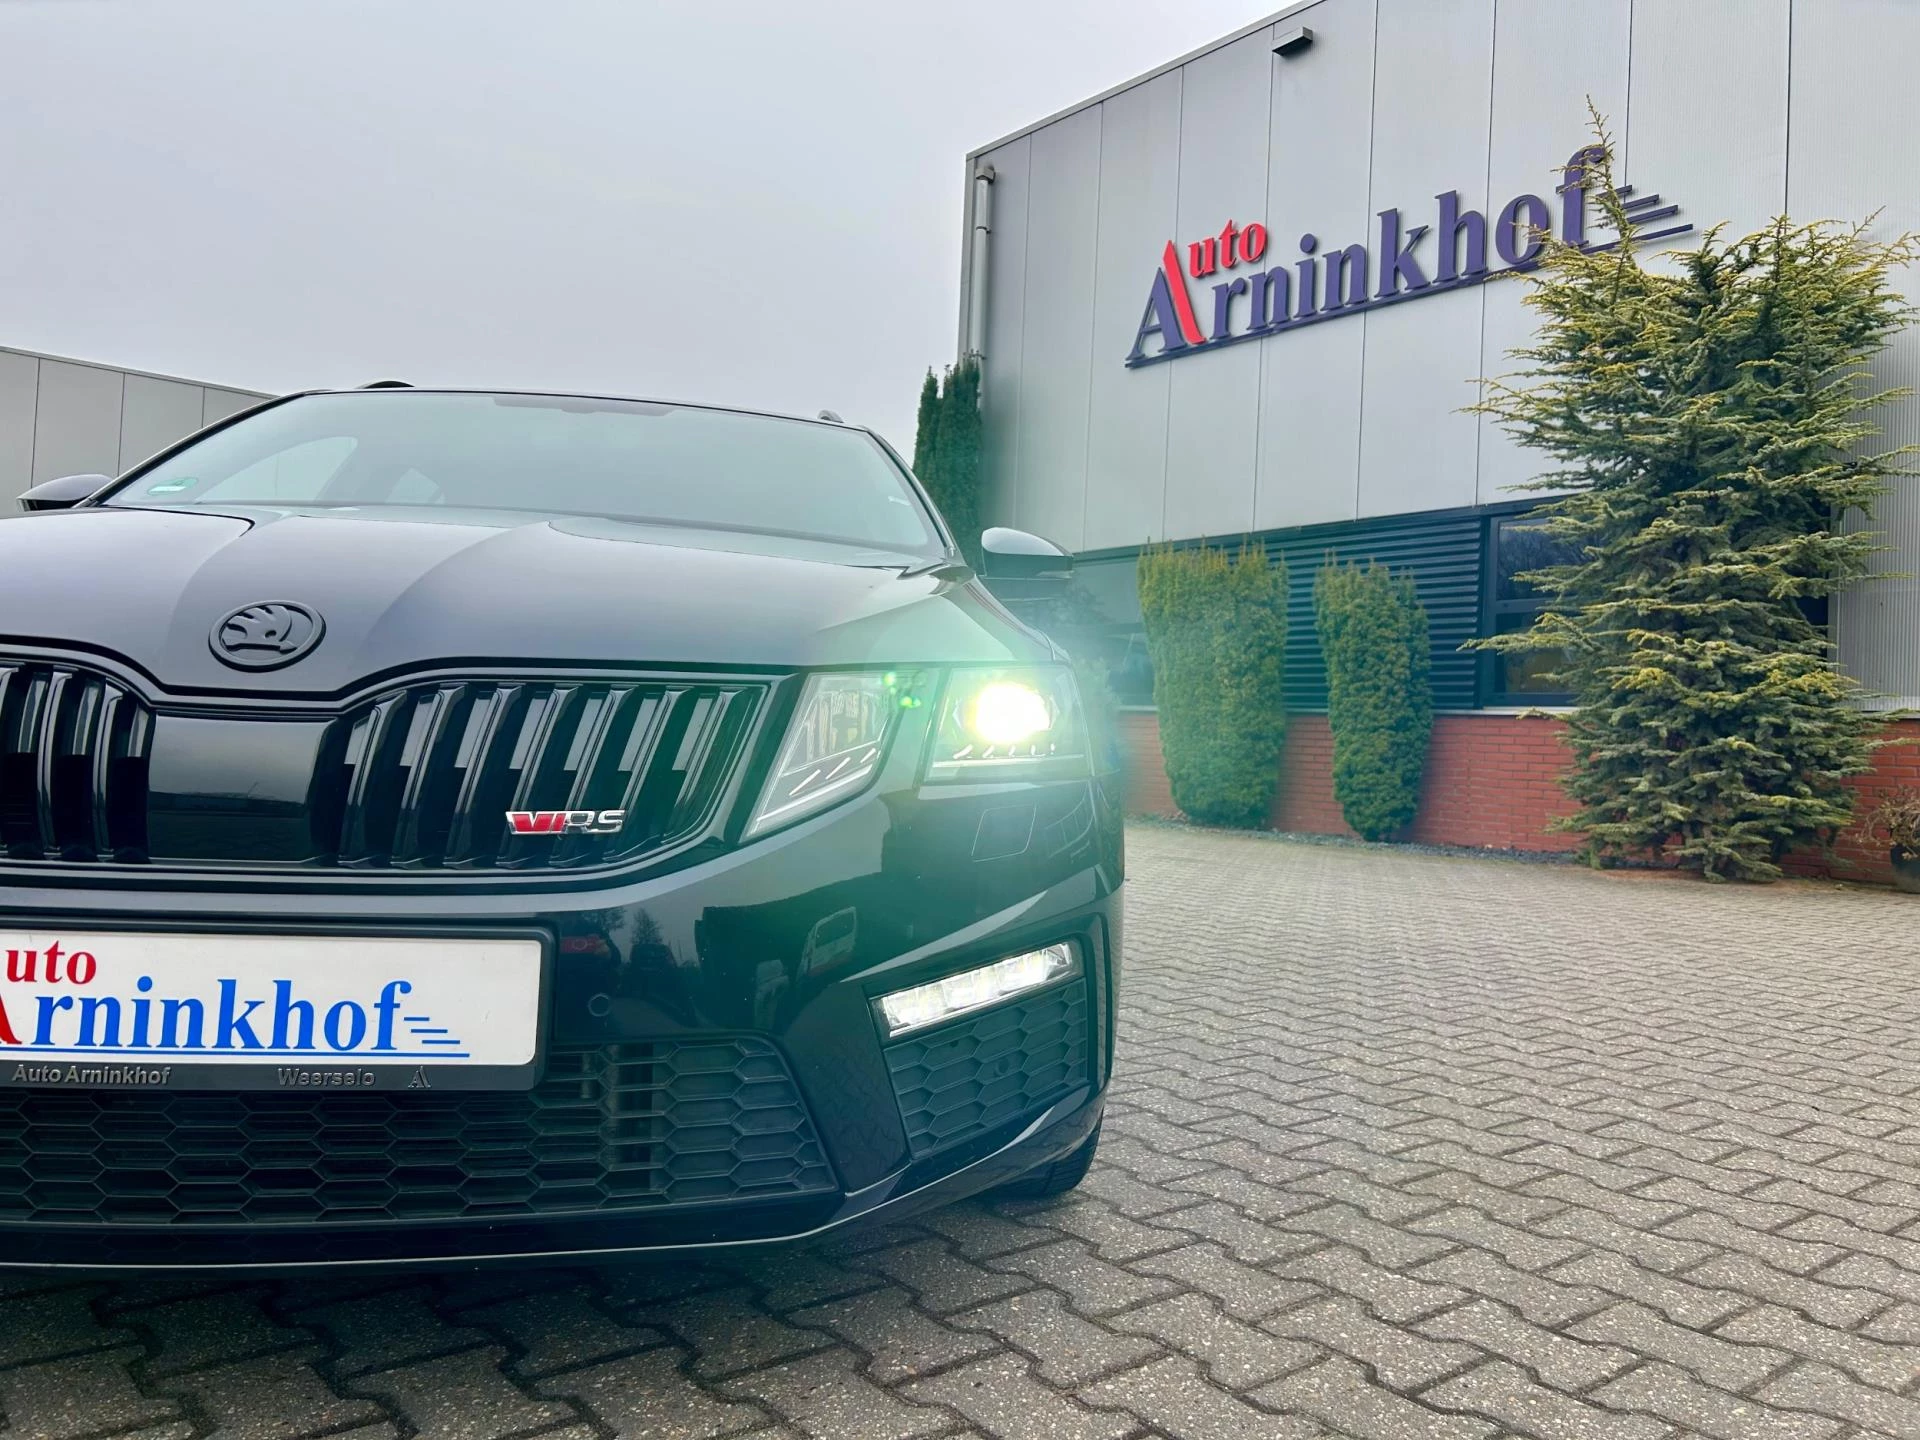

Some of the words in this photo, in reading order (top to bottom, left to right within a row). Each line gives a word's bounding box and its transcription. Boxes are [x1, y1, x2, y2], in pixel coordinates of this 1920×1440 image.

[1126, 144, 1606, 362] Arninkhof
[0, 940, 97, 985] uto
[12, 1064, 62, 1083] Auto
[64, 1065, 171, 1086] Arninkhof
[277, 1067, 376, 1087] Weerselo
